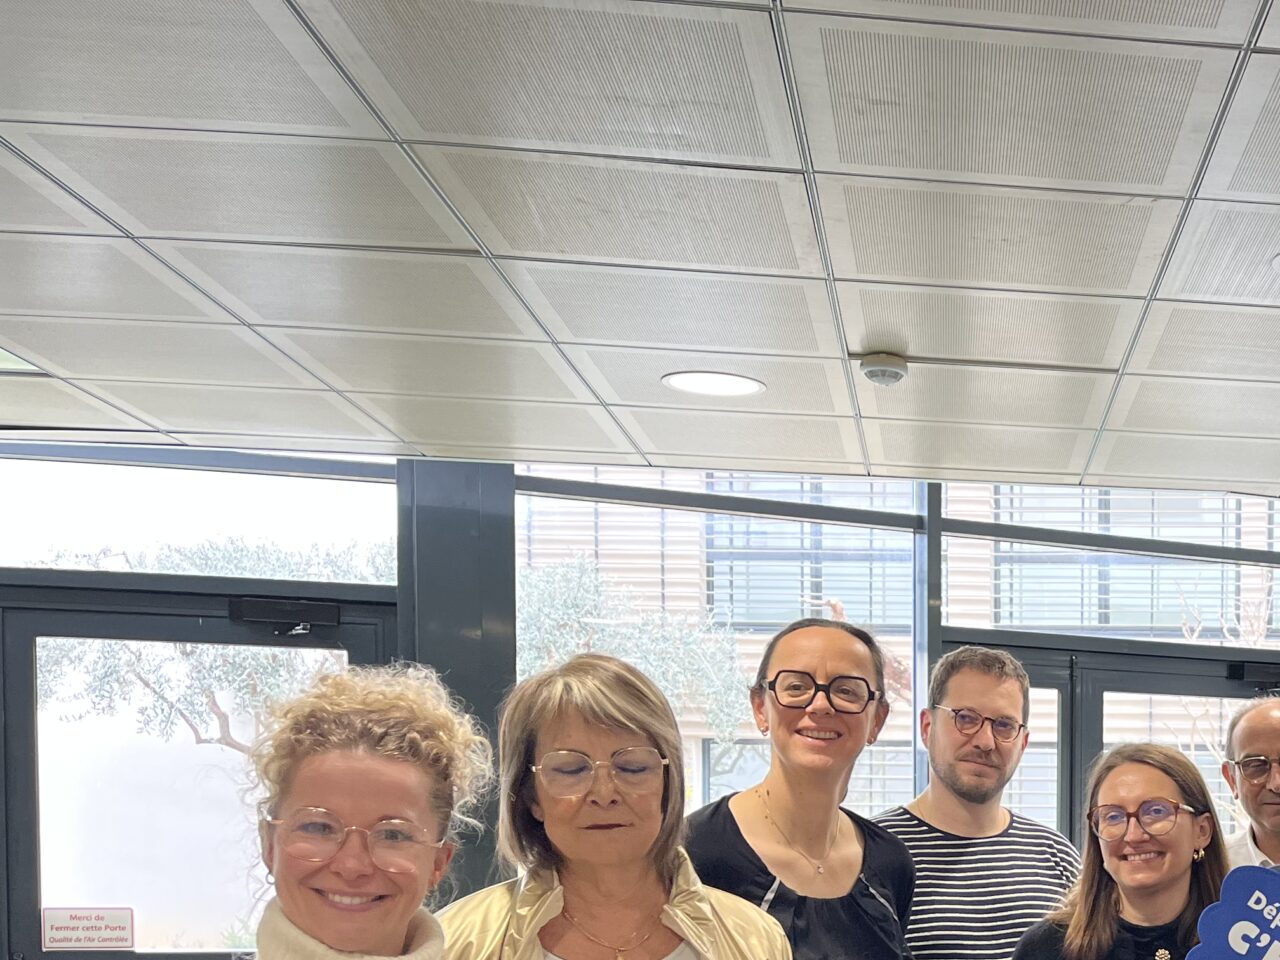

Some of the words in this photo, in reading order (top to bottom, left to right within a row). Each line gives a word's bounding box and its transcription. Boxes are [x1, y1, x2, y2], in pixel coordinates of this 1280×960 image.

[50, 924, 80, 932] Fermer
[82, 924, 103, 932] cette
[104, 924, 127, 932] Porte
